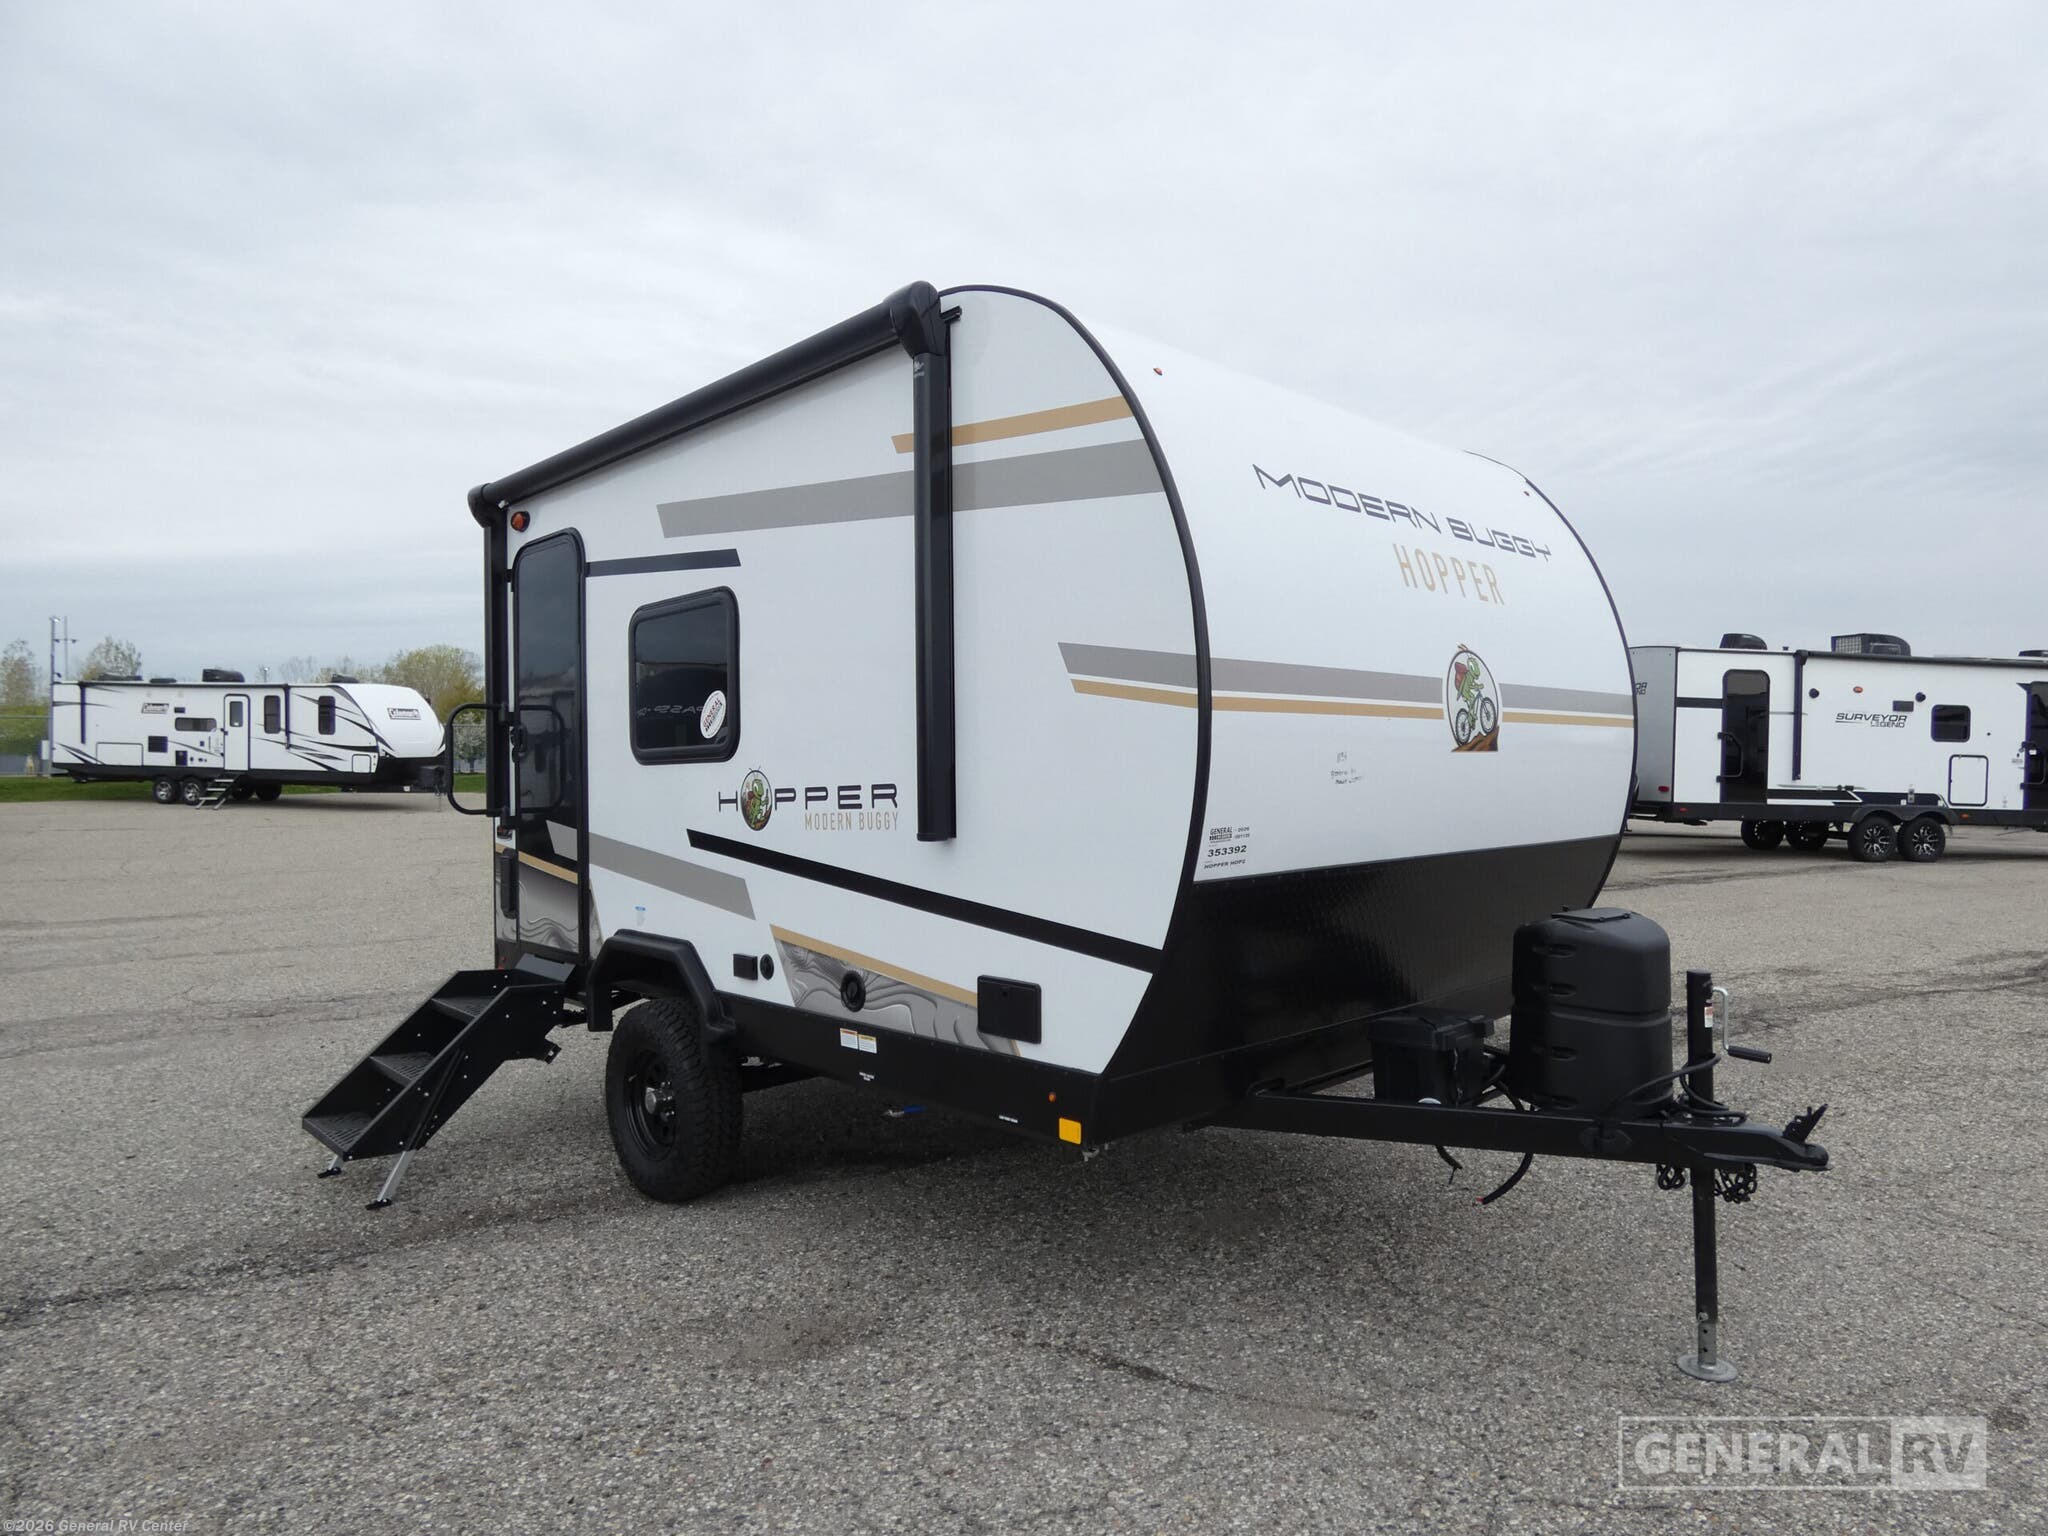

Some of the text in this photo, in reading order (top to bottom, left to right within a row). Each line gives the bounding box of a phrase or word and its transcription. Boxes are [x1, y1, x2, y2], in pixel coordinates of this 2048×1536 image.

[1252, 463, 1552, 562] MODERN BUGGY
[1392, 543, 1505, 606] HOPPER
[1836, 712, 1908, 722] SURVEYOR
[1870, 720, 1906, 728] LEGEND
[804, 811, 899, 831] MODERN BUGGY
[1207, 845, 1247, 857] 353392
